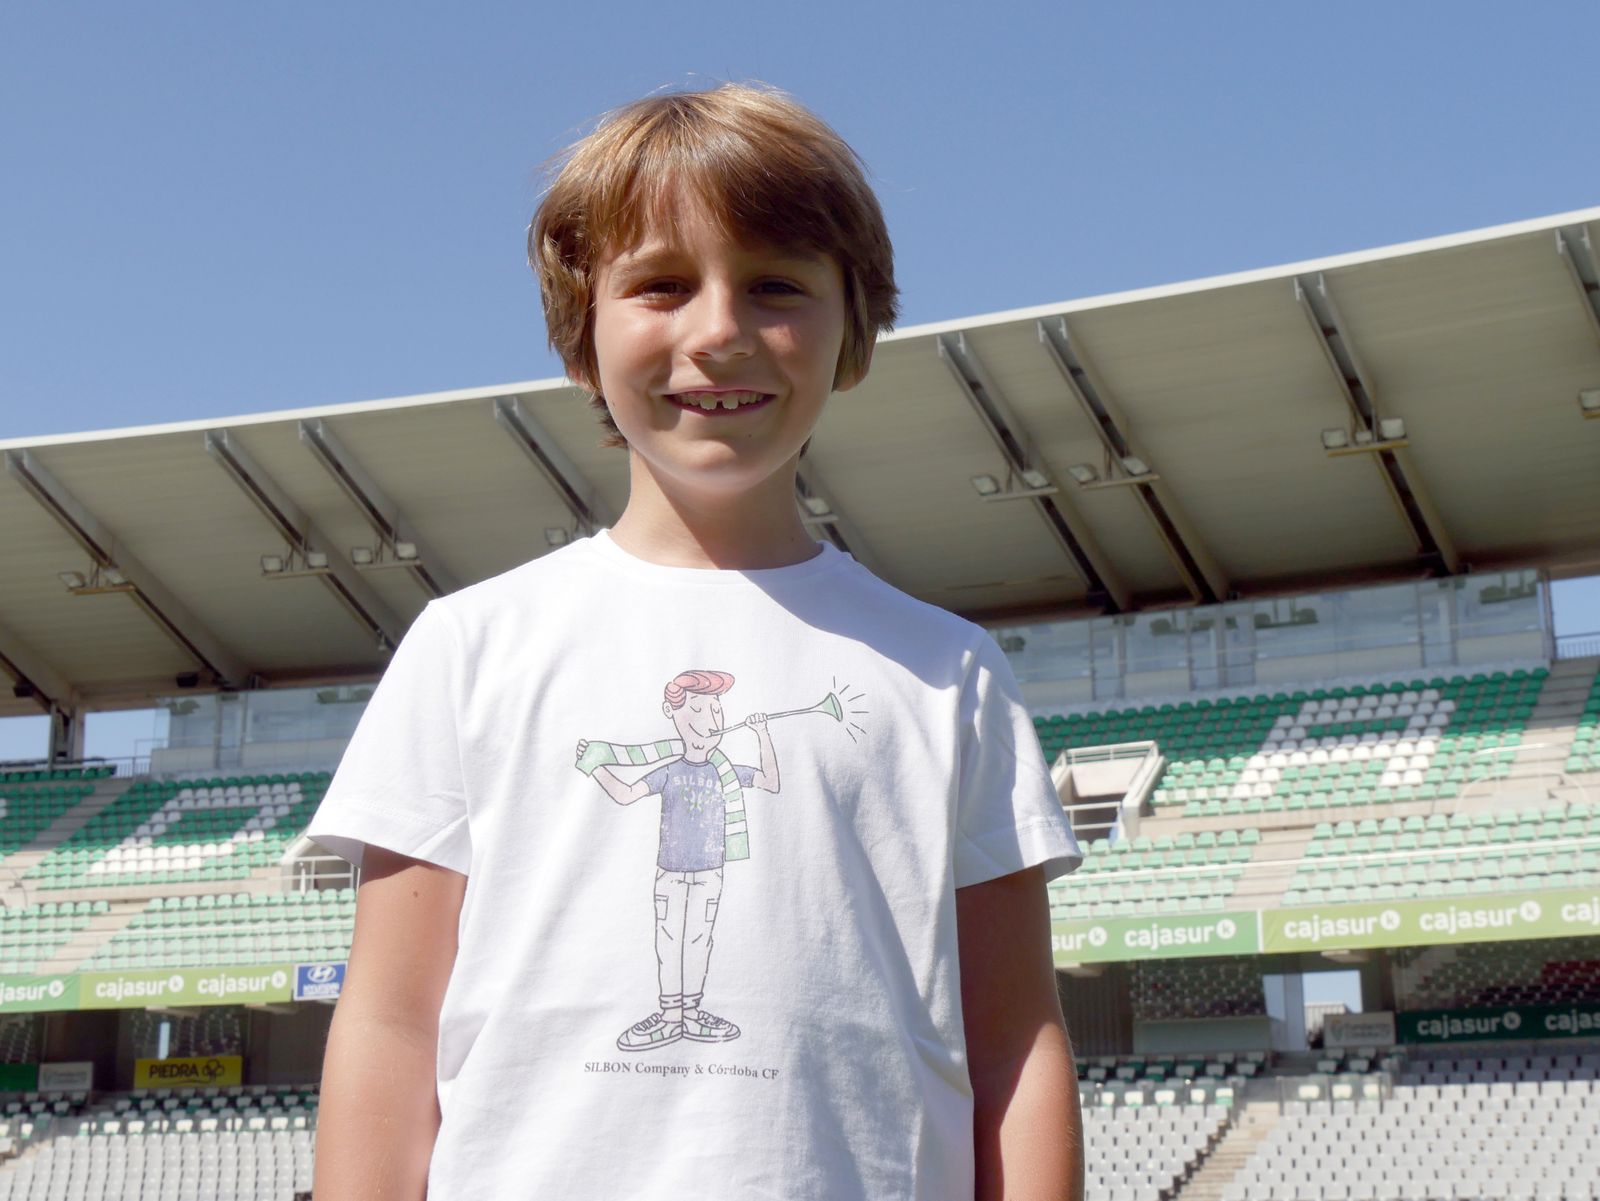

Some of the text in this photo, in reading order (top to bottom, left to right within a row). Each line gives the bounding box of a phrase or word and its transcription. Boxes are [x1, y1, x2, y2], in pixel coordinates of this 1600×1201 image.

[1284, 914, 1378, 942] cajasur
[1419, 906, 1517, 934] cajasur
[1124, 923, 1215, 950] cajasur
[95, 976, 167, 1001] cajasur
[197, 974, 271, 997] cajasur
[1417, 1014, 1500, 1038] cajasur
[149, 1063, 199, 1079] PIEDRA
[584, 1062, 780, 1079] SILBON Company & Córdoba CF
